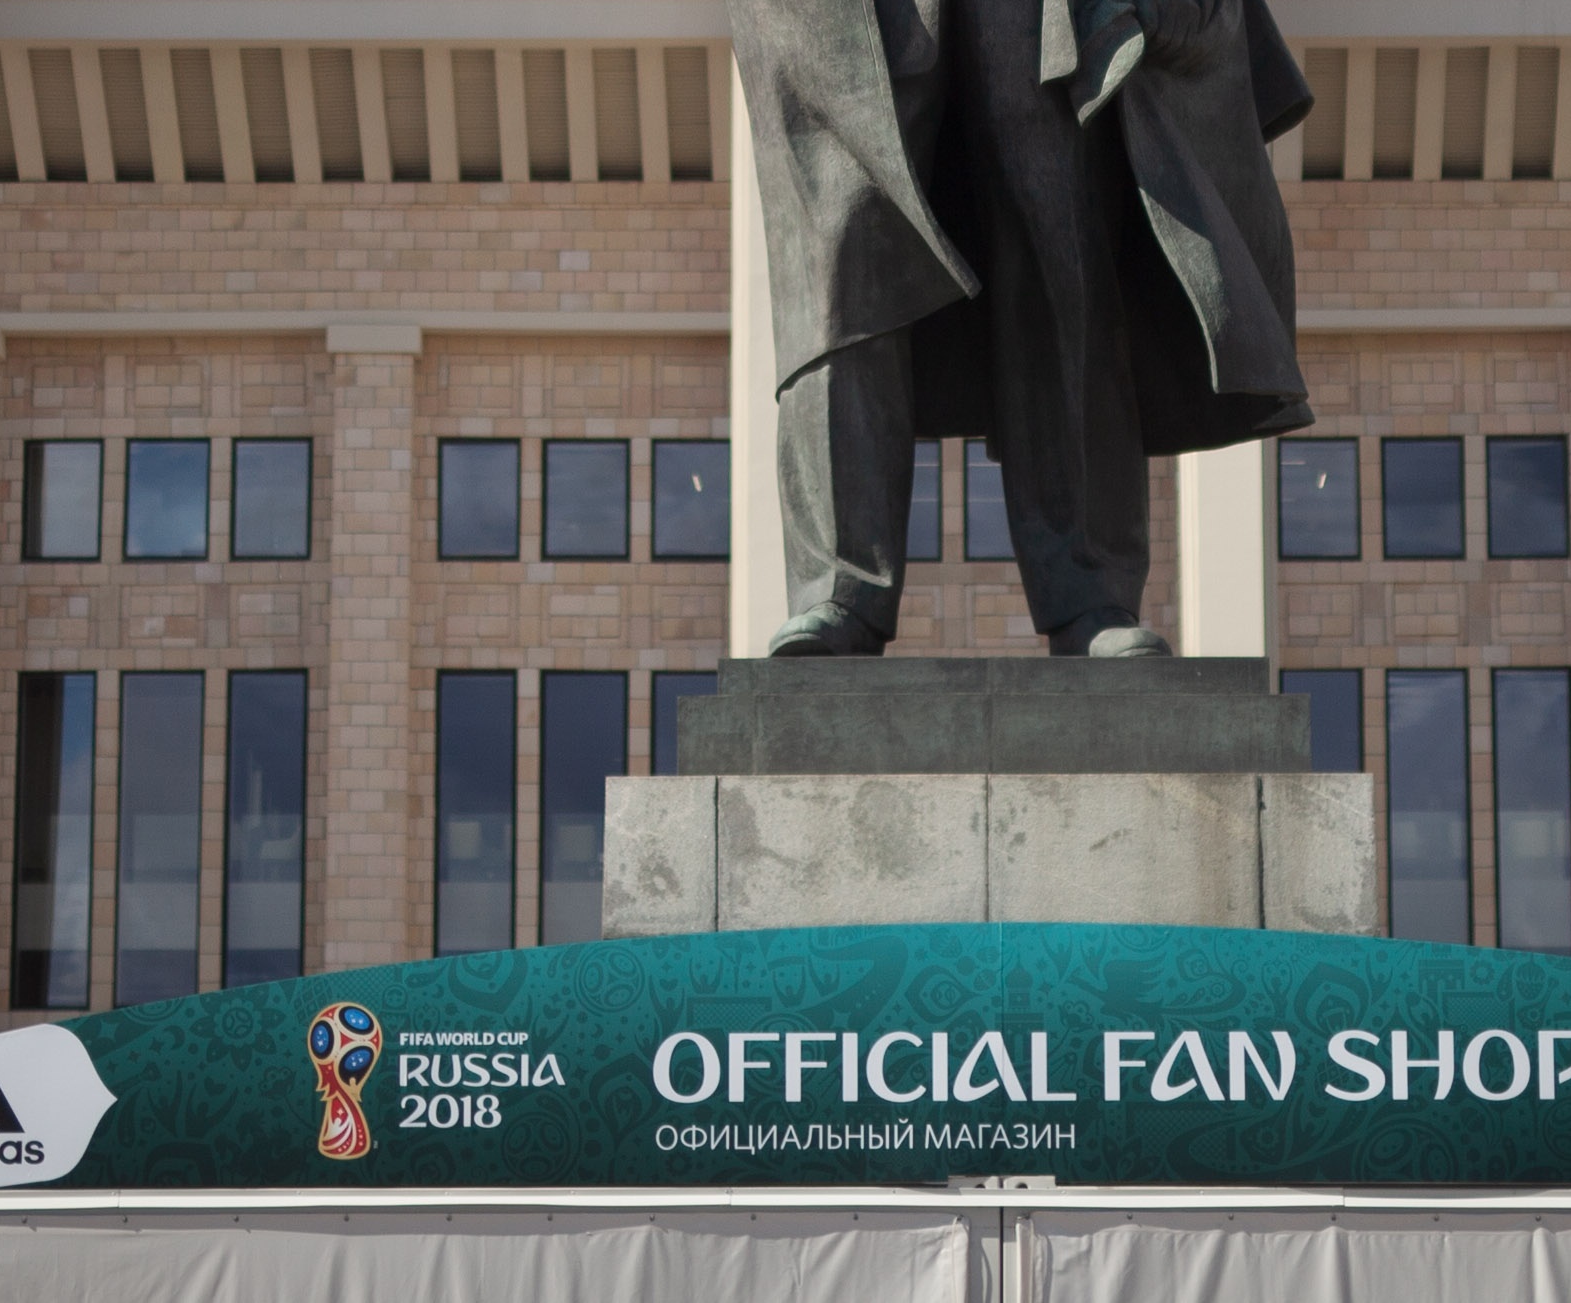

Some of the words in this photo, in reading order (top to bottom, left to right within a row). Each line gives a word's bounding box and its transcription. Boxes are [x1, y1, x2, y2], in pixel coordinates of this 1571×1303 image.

[399, 1032, 432, 1046] FIFA
[436, 1032, 495, 1046] WORLD
[496, 1032, 529, 1046] CUP
[399, 1052, 566, 1088] RUSSIA
[652, 1030, 1077, 1104] OFFICIAL
[1103, 1030, 1296, 1102] FAN
[399, 1093, 502, 1129] 2018
[655, 1118, 914, 1155] ОФИЦИАЛЬНЫЙ
[924, 1123, 1075, 1150] МАГАЗИН
